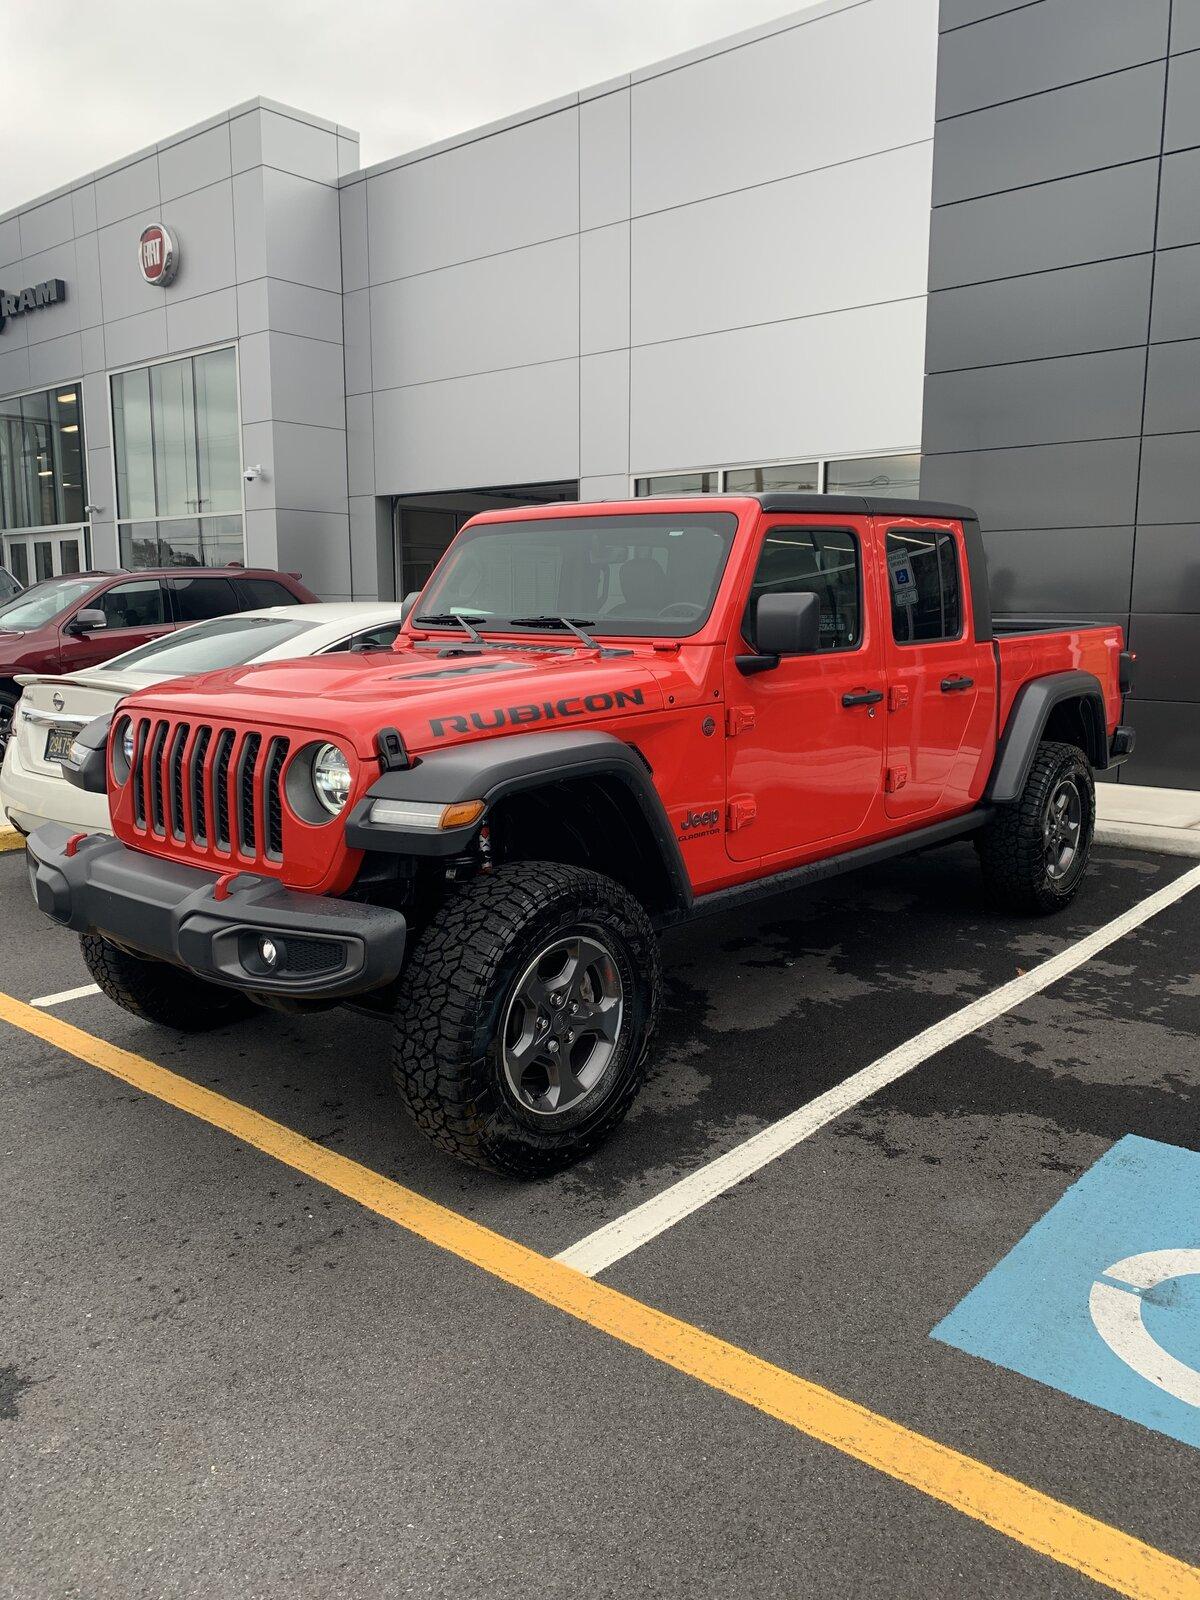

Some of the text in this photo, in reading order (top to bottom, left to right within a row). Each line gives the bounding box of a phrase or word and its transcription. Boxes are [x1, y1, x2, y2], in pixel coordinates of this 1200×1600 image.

[143, 237, 162, 269] FIAT
[1, 279, 60, 317] RAM
[429, 688, 645, 738] RUBICON
[681, 807, 720, 831] Jeep
[678, 828, 721, 843] GLADIATOR
